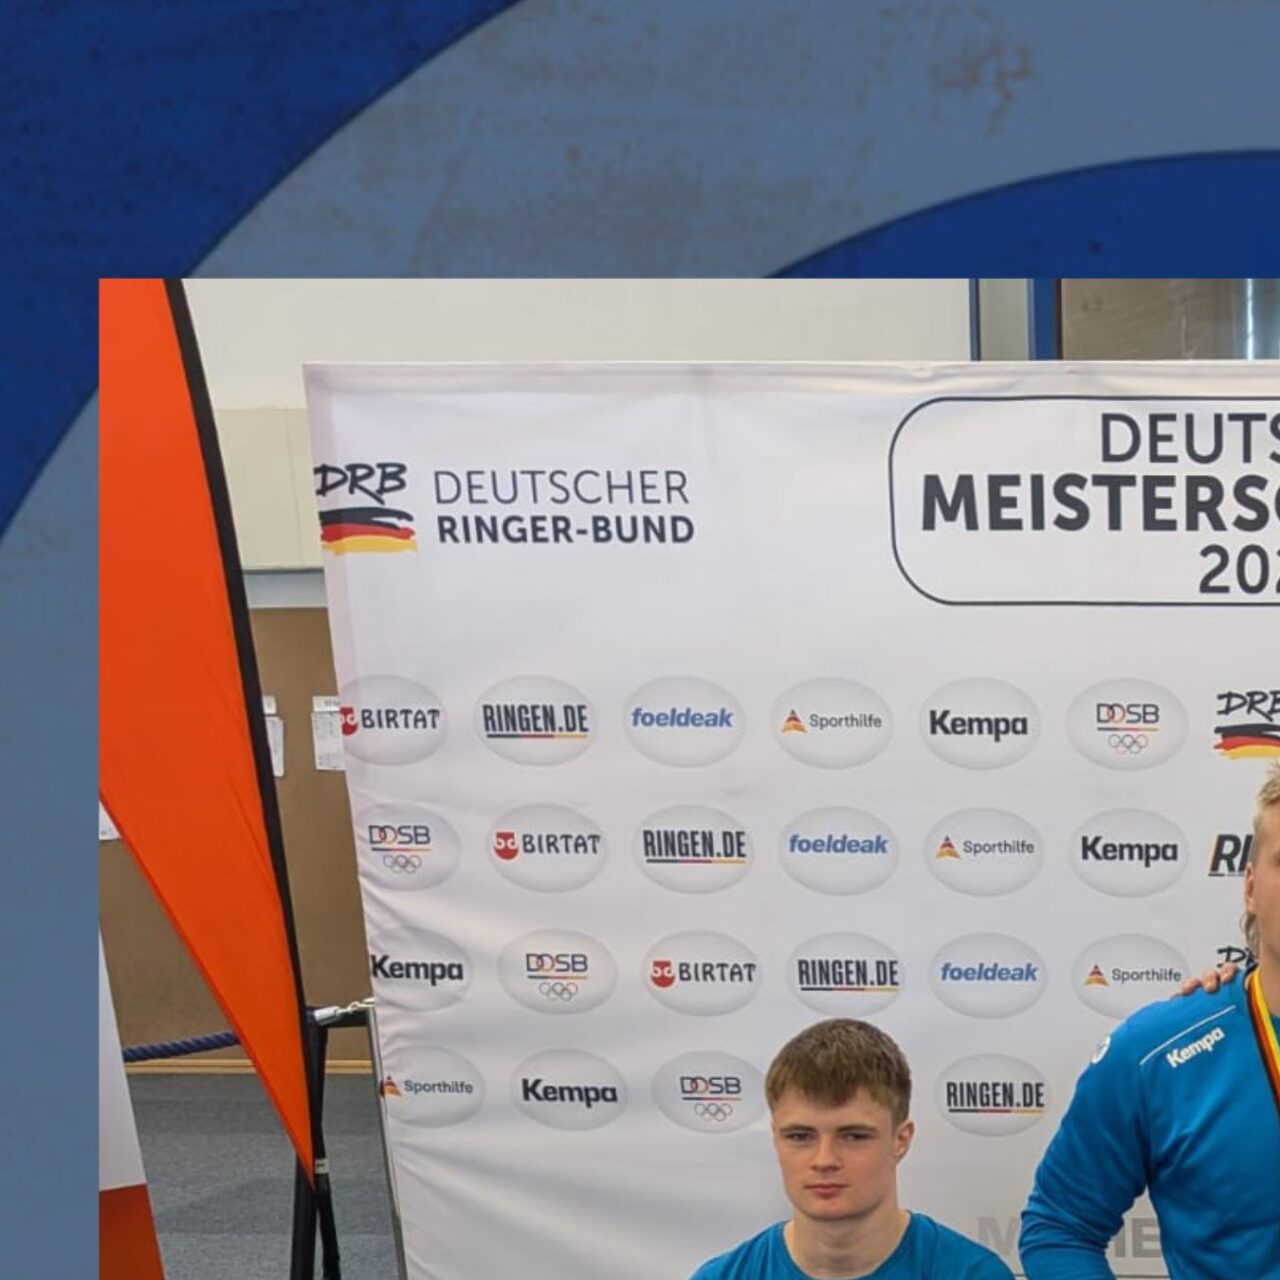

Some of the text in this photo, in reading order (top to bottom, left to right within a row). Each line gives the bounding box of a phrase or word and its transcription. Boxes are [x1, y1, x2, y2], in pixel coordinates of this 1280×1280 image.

[313, 463, 406, 505] DRB
[434, 470, 688, 504] DEUTSCHER
[438, 516, 694, 543] RINGER-BUND
[361, 709, 440, 728] BIRTAT
[483, 705, 588, 732] RINGEN.DE
[632, 708, 732, 727] foeldeak
[810, 714, 882, 730] Sporthilfe
[1097, 703, 1159, 723] DOSB
[930, 710, 1027, 742] Kempa
[368, 825, 430, 844] DOSB
[523, 834, 600, 853] BIRTAT
[643, 830, 746, 857] RINGEN.DE
[790, 835, 887, 853] foeldeak
[963, 840, 1034, 855] Sporthilfe
[1082, 836, 1177, 867] Kempa
[370, 955, 463, 988] Kempa
[526, 954, 588, 972] DOSB
[679, 963, 756, 982] BIRTAT
[942, 963, 1037, 981] foeldeak
[798, 960, 898, 986] RINGEN.DE
[1112, 968, 1181, 983] Sporthilfe
[1166, 1027, 1225, 1068] Kempa
[404, 1080, 473, 1094] Sporthilfe
[522, 1079, 618, 1108] Kempa
[680, 1077, 741, 1094] DOSB
[947, 1082, 1044, 1110] RINGEN.DE
